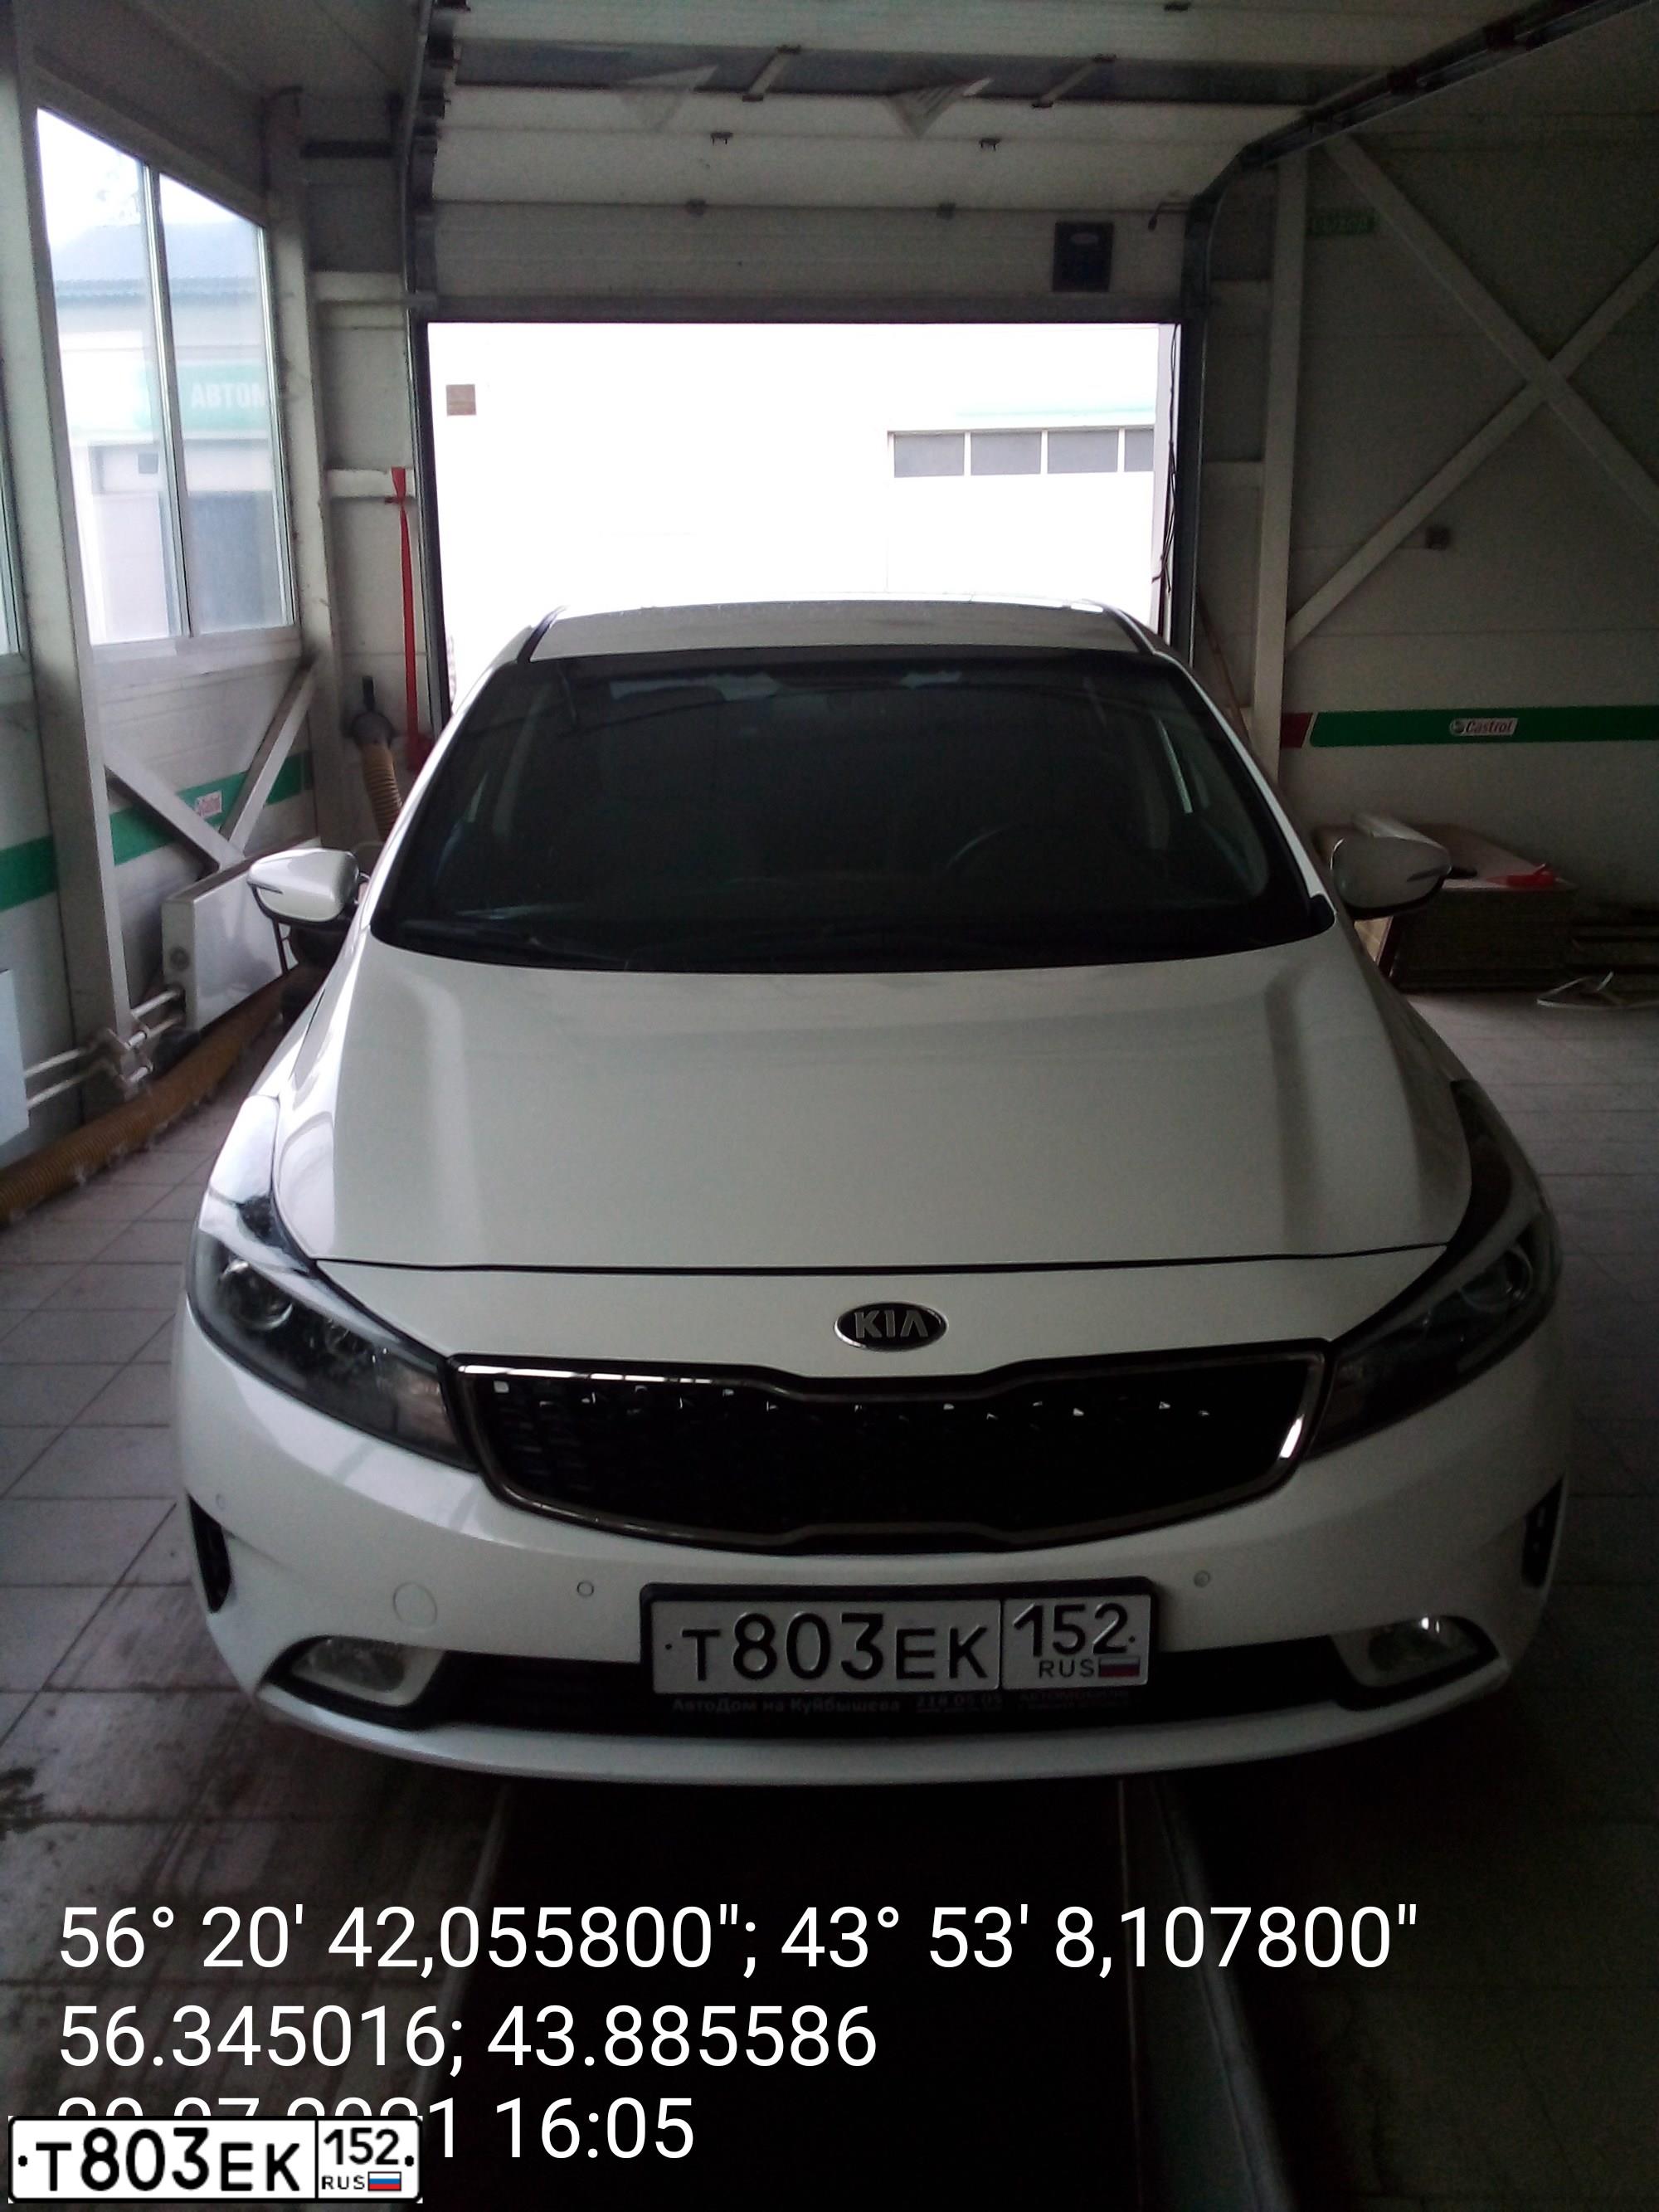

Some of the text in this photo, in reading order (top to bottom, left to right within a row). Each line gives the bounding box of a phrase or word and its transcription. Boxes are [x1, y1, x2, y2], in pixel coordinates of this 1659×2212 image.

[1466, 720, 1515, 733] Castrol
[854, 1309, 928, 1339] KIA
[1013, 1602, 1126, 1658] 152
[1038, 1659, 1094, 1678] RUS
[672, 1697, 757, 1715] АвтоДом
[790, 1696, 901, 1714] Куйбышева
